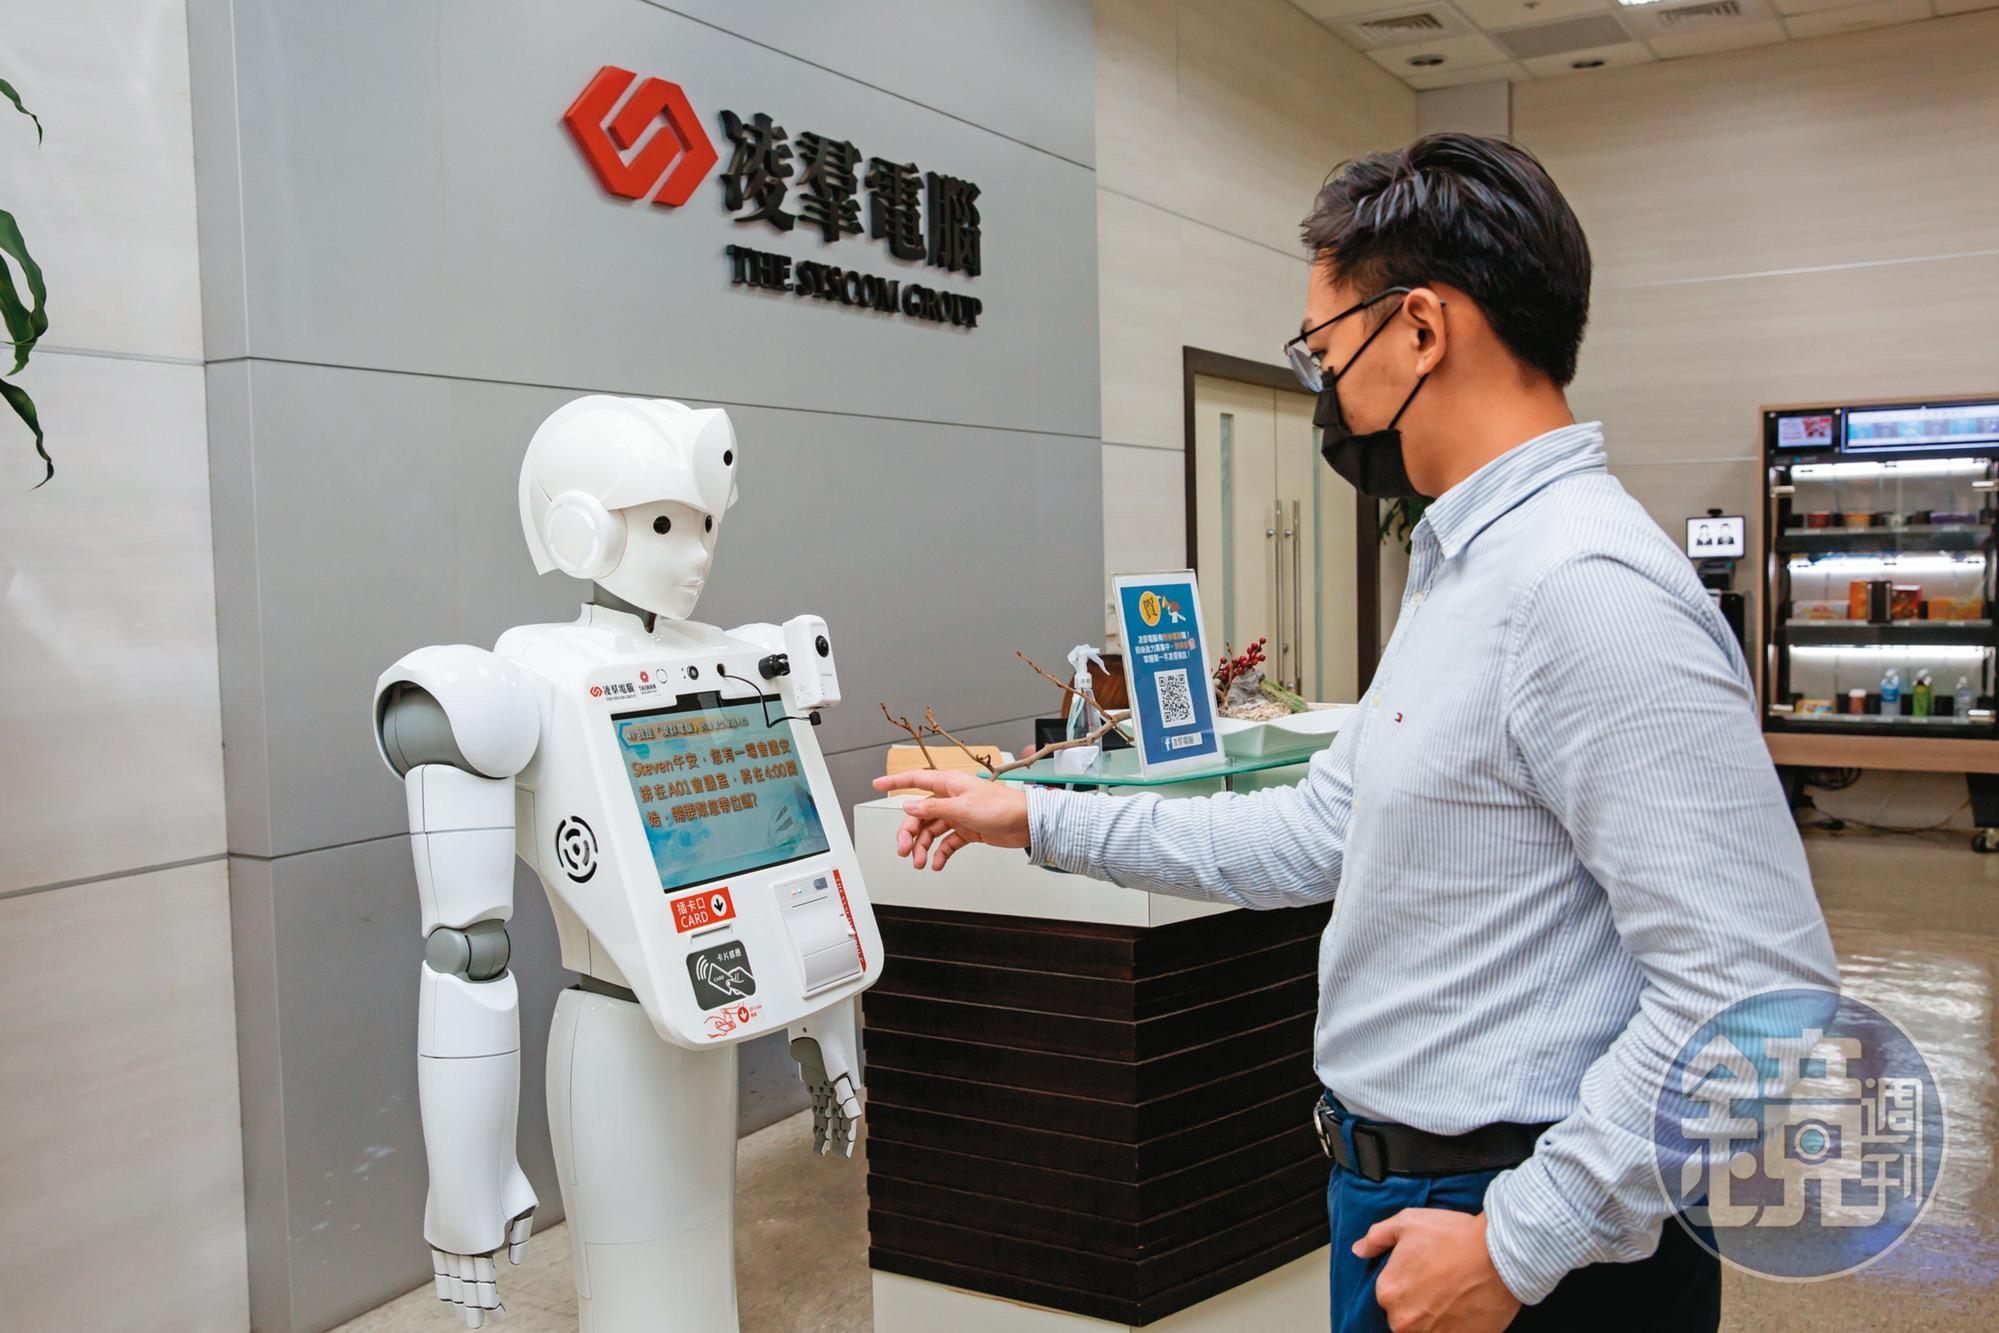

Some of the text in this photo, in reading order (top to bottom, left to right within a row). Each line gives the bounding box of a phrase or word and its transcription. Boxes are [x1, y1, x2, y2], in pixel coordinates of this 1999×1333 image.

[727, 244, 983, 328] THE SYSCOM GROUP
[677, 897, 706, 915] 插卡口
[681, 911, 709, 928] CARD
